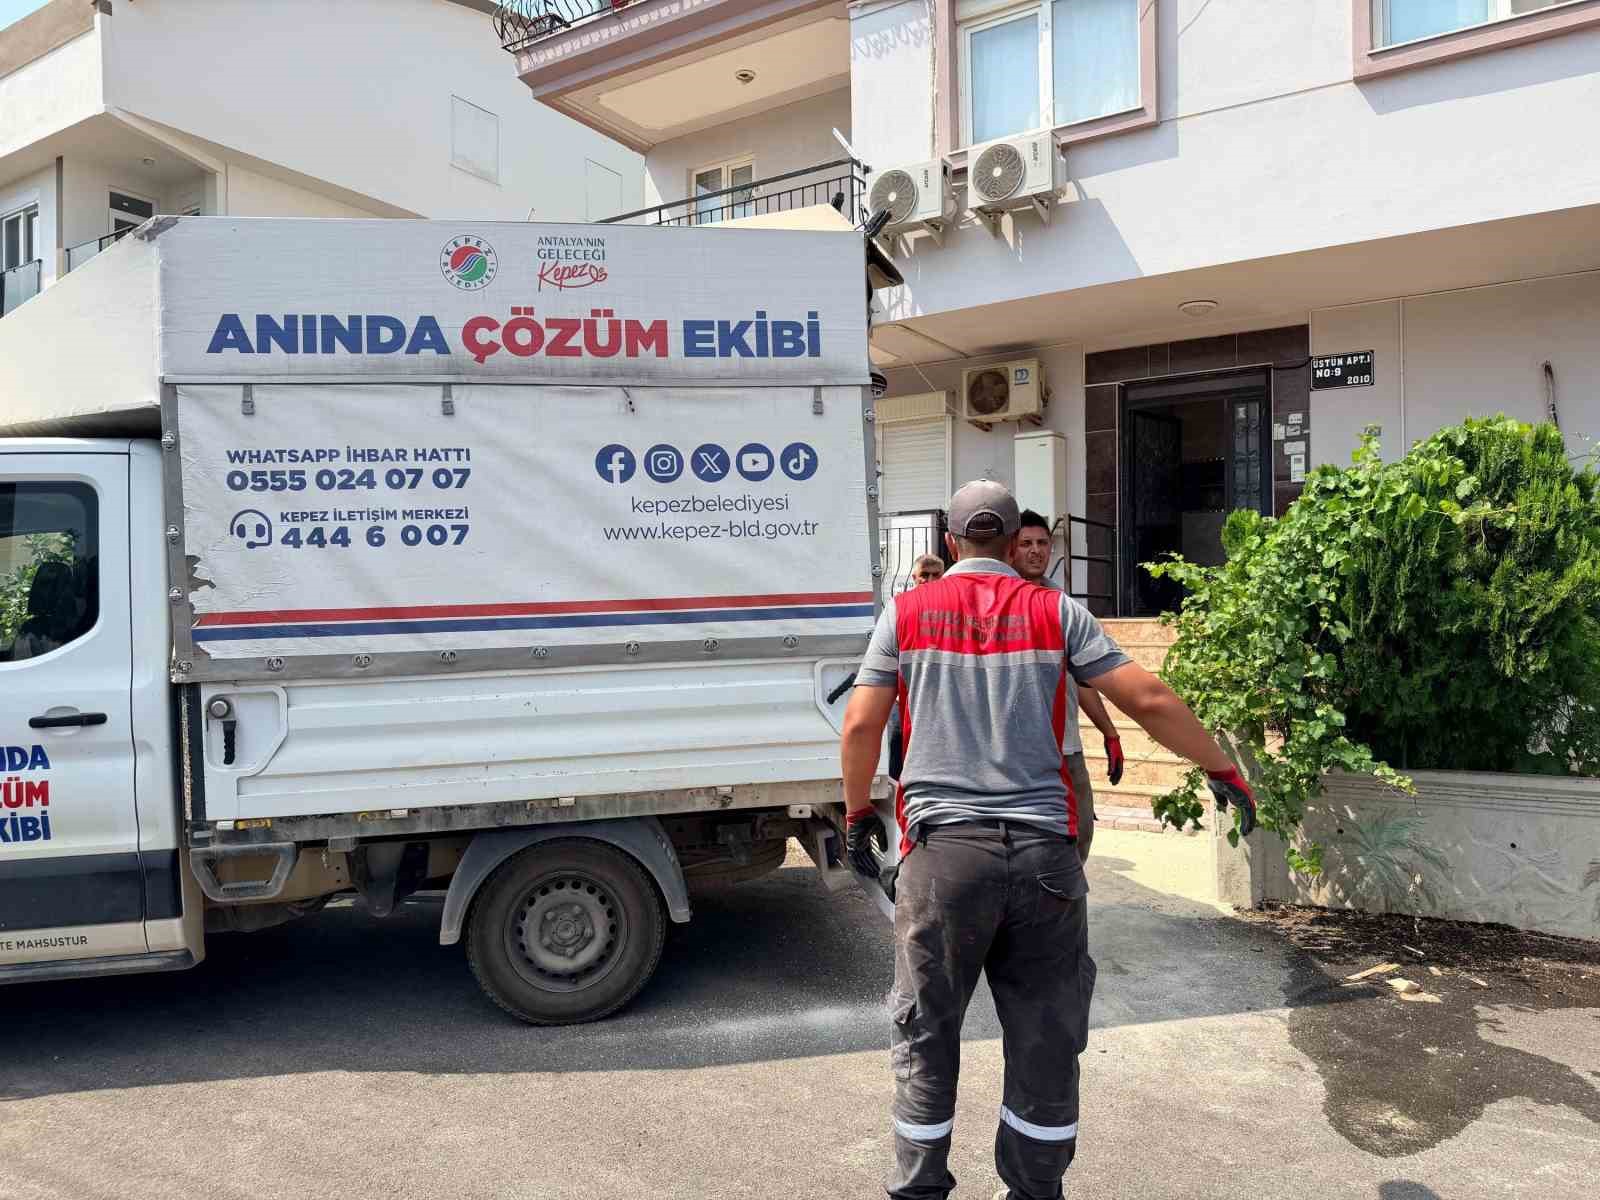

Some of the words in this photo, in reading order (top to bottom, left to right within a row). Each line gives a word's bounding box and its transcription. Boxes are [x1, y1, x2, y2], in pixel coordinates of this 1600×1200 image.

[537, 236, 605, 247] ANTALYA'NIN
[206, 313, 452, 355] ANINDA
[461, 306, 668, 364] ÇÖZÜM
[683, 310, 821, 358] EKİBİ
[1347, 374, 1370, 385] 2010
[226, 449, 340, 463] WHATSAPP
[346, 446, 408, 462] İHBAR
[413, 448, 471, 462] HATTI
[226, 469, 307, 492] 0555
[315, 468, 377, 490] 024
[385, 468, 424, 490] 07
[432, 468, 471, 489] 07
[280, 511, 329, 523] KEPEZ
[333, 508, 398, 522] İLETİŞİM
[402, 506, 469, 521] MERKEZİ
[631, 493, 789, 515] kepezbelediyesi
[281, 526, 352, 549] 444
[366, 526, 386, 547] 6
[400, 524, 470, 547] 007
[603, 520, 819, 541] www.kepez-bld.gov.tr
[0, 776, 49, 809] ÜM
[16, 935, 88, 951] MAHSUSTUR
